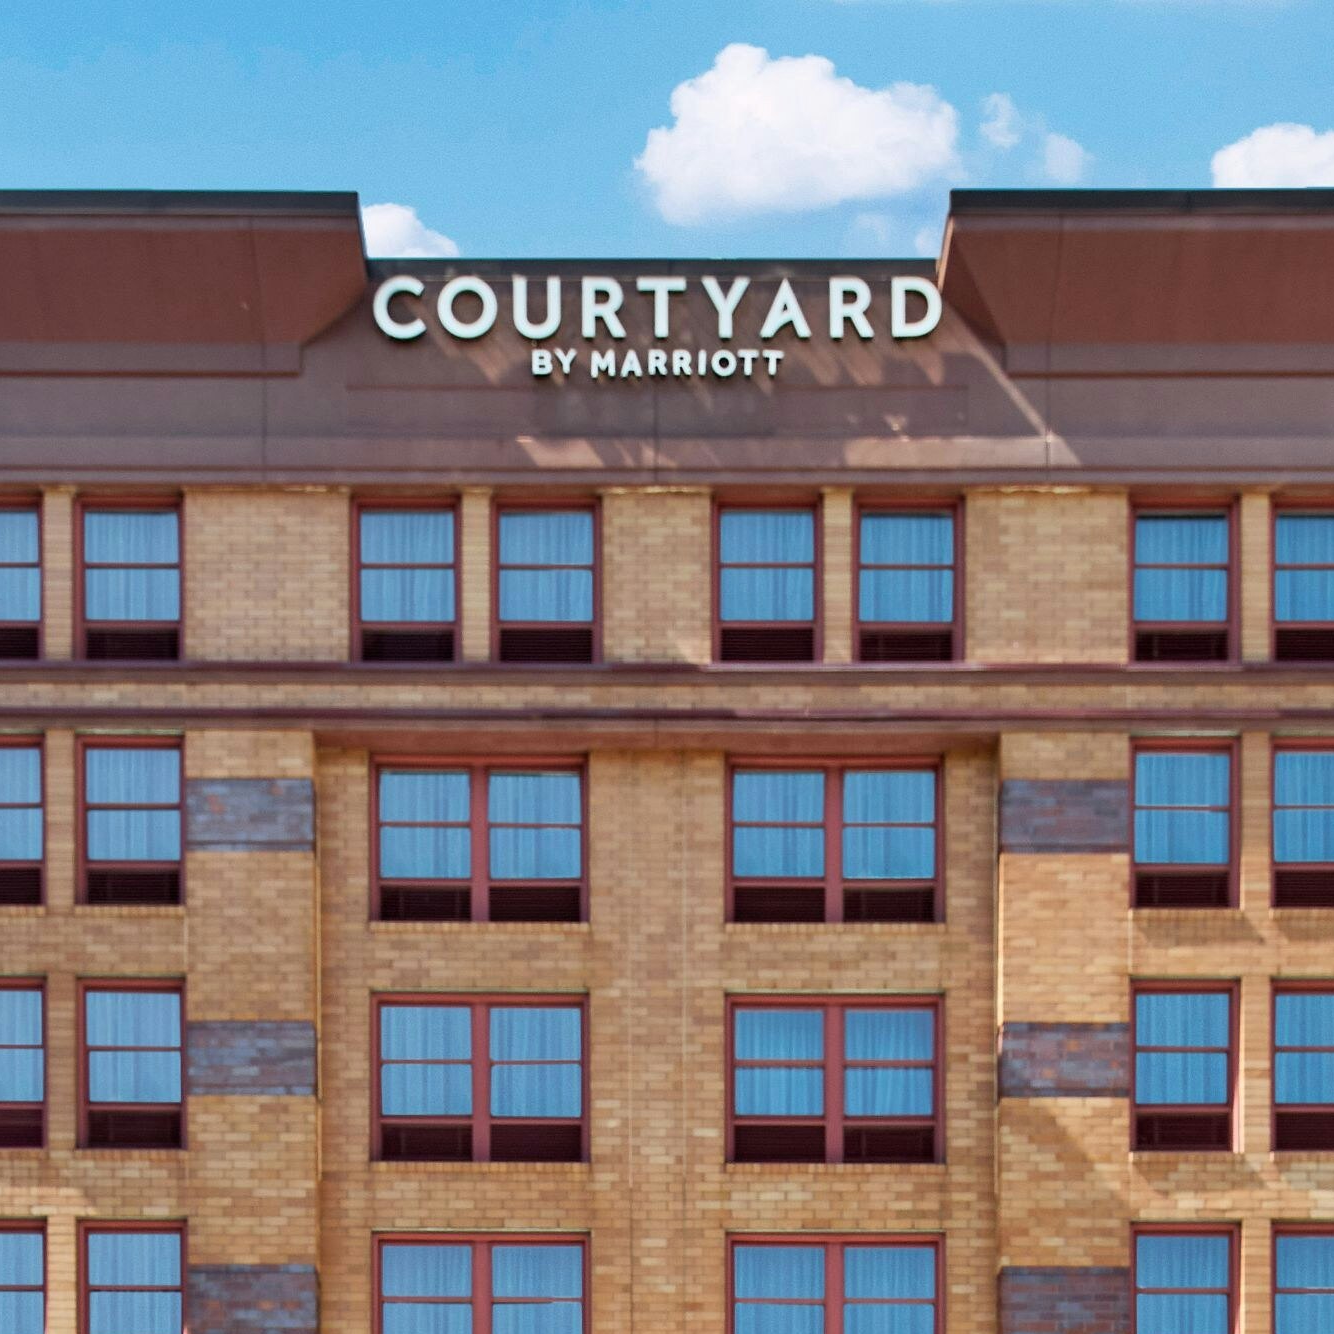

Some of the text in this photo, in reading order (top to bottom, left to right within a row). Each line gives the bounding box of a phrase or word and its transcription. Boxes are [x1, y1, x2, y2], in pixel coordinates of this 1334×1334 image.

[371, 275, 943, 340] COURTYARD
[531, 348, 785, 378] BY MARRIOTT
